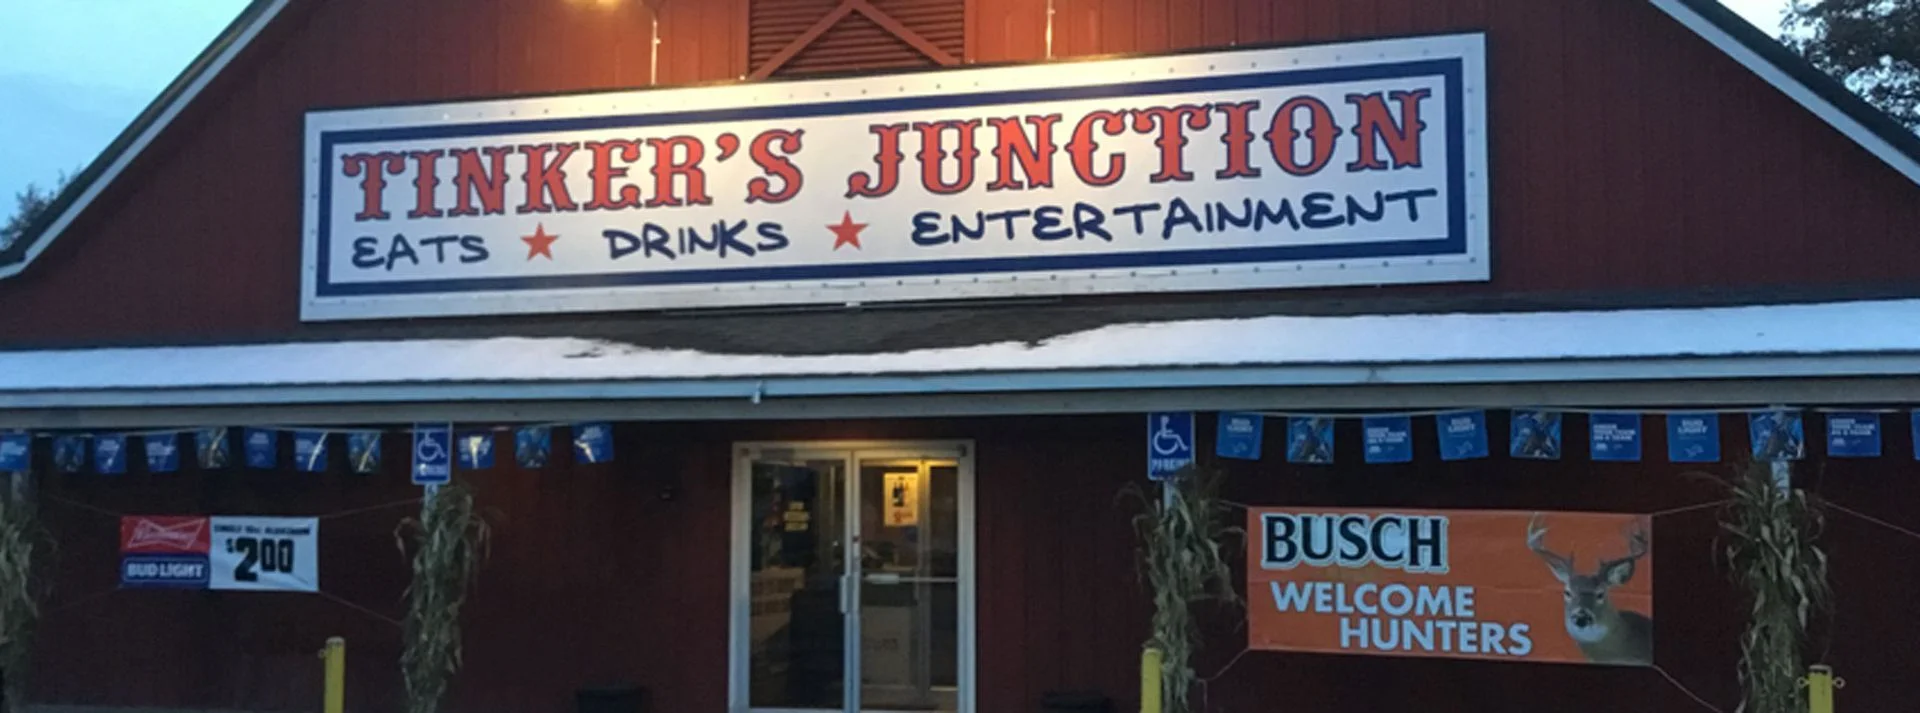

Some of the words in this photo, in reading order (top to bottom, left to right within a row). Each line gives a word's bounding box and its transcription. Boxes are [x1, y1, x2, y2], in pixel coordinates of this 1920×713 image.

[341, 128, 805, 222] TINKER'S
[845, 89, 1432, 198] JUNCTION
[351, 234, 489, 271] EATS
[602, 219, 789, 261] DRINKS
[910, 188, 1438, 247] ENTERTAINMENT
[1261, 513, 1448, 572] BUSCH
[127, 562, 158, 578] BUD
[159, 562, 204, 578] LIGHT
[1270, 581, 1475, 617] WELCOME
[1340, 617, 1532, 656] HUNTERS
